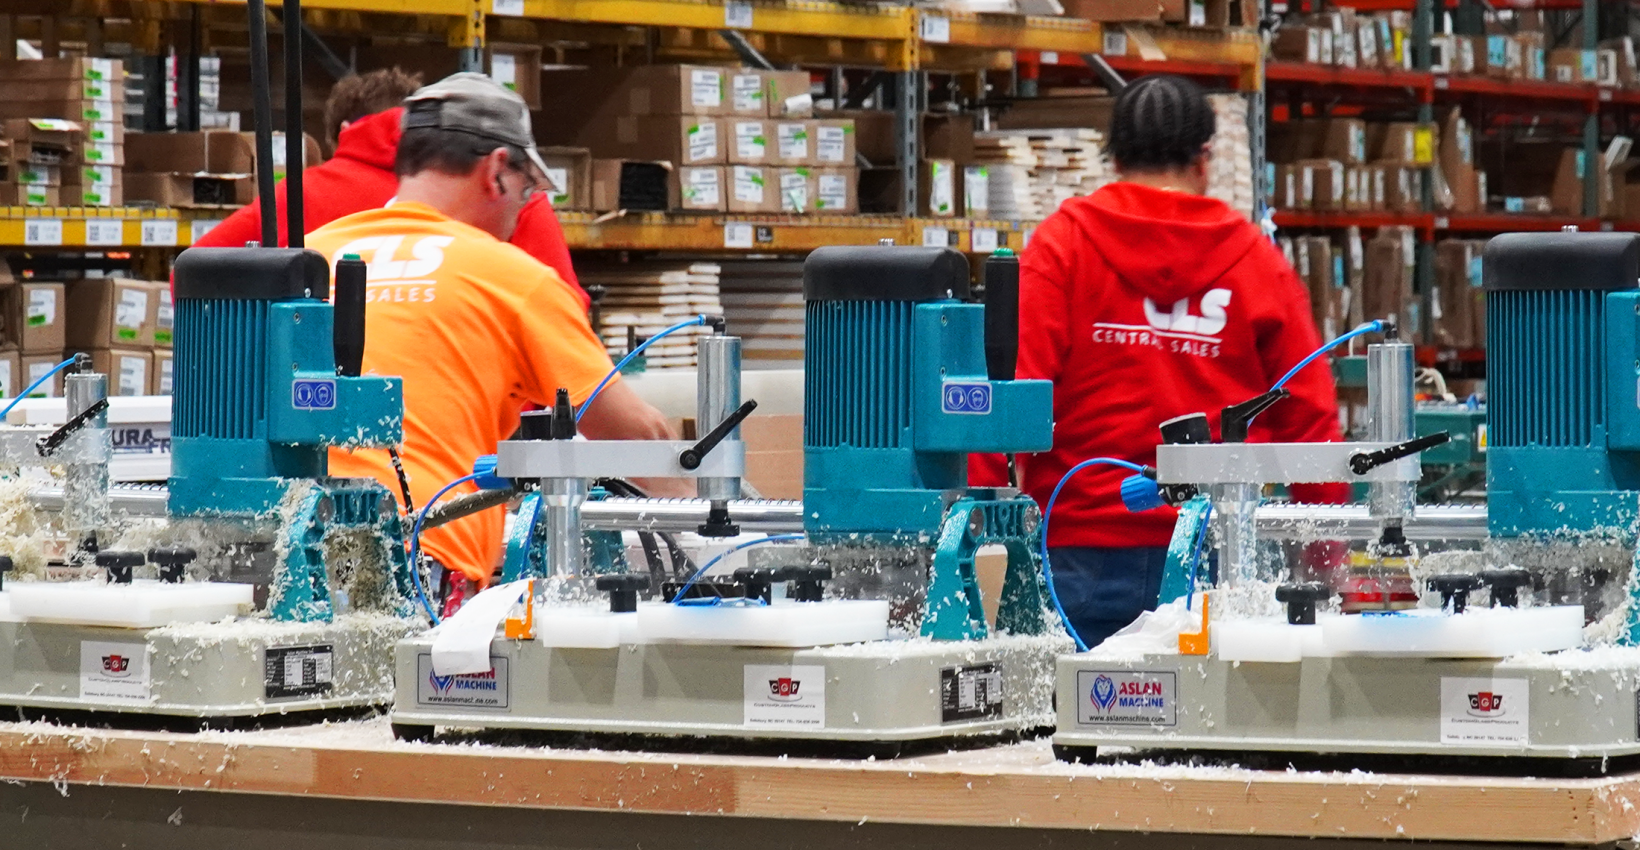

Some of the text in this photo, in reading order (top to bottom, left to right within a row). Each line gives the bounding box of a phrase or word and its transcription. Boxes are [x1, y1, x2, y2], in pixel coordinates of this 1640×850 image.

[331, 234, 456, 280] CLS
[366, 287, 436, 303] SALES
[1170, 340, 1220, 358] SALES
[103, 659, 127, 669] CGP
[455, 680, 497, 690] MACHINE
[771, 683, 798, 693] CGP
[1119, 682, 1162, 695] ASLAN
[1470, 697, 1500, 708] CGP
